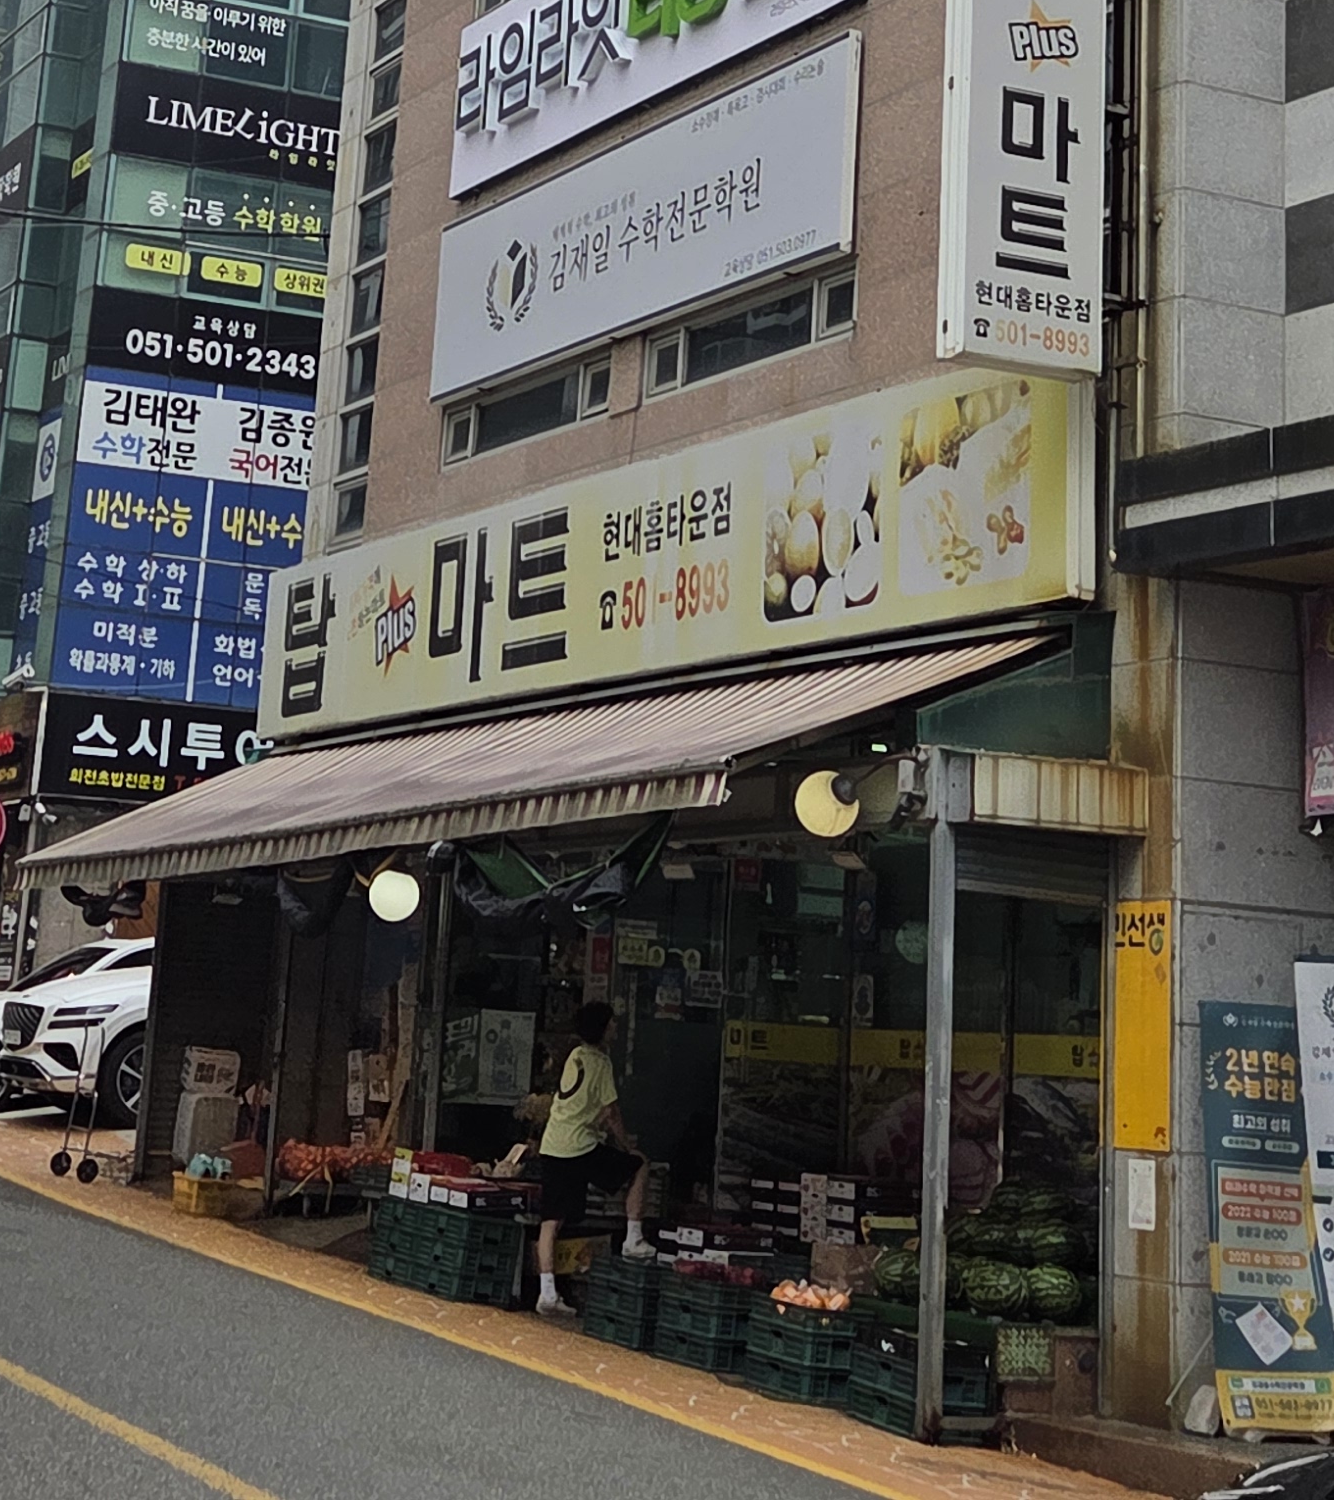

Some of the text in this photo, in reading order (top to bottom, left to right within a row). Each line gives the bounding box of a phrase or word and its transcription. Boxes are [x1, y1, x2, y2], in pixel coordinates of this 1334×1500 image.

[180, 1, 208, 22] 꿈을
[213, 7, 255, 31] 이루기
[258, 15, 286, 37] 위한
[146, 27, 266, 66] 충분한 시간이 있어
[1009, 22, 1079, 60] Plus
[996, 85, 1081, 280] 마트
[548, 225, 612, 293] 김재일
[618, 157, 763, 263] 수학전문학원
[141, 252, 173, 270] 내신
[216, 263, 247, 281] 수능
[285, 274, 325, 293] 상위권
[975, 281, 1092, 323] 현대홈타운점
[193, 315, 257, 338] 교육상담
[103, 389, 201, 433] 김태완
[92, 432, 197, 471] 수학전문
[85, 488, 192, 537] 내신+수능
[602, 480, 735, 563] 현대홈타운점
[77, 552, 126, 578] 수학
[74, 578, 124, 604] 수학
[282, 573, 338, 720] 탑
[427, 506, 570, 684] 마트
[150, 658, 175, 680] 기하
